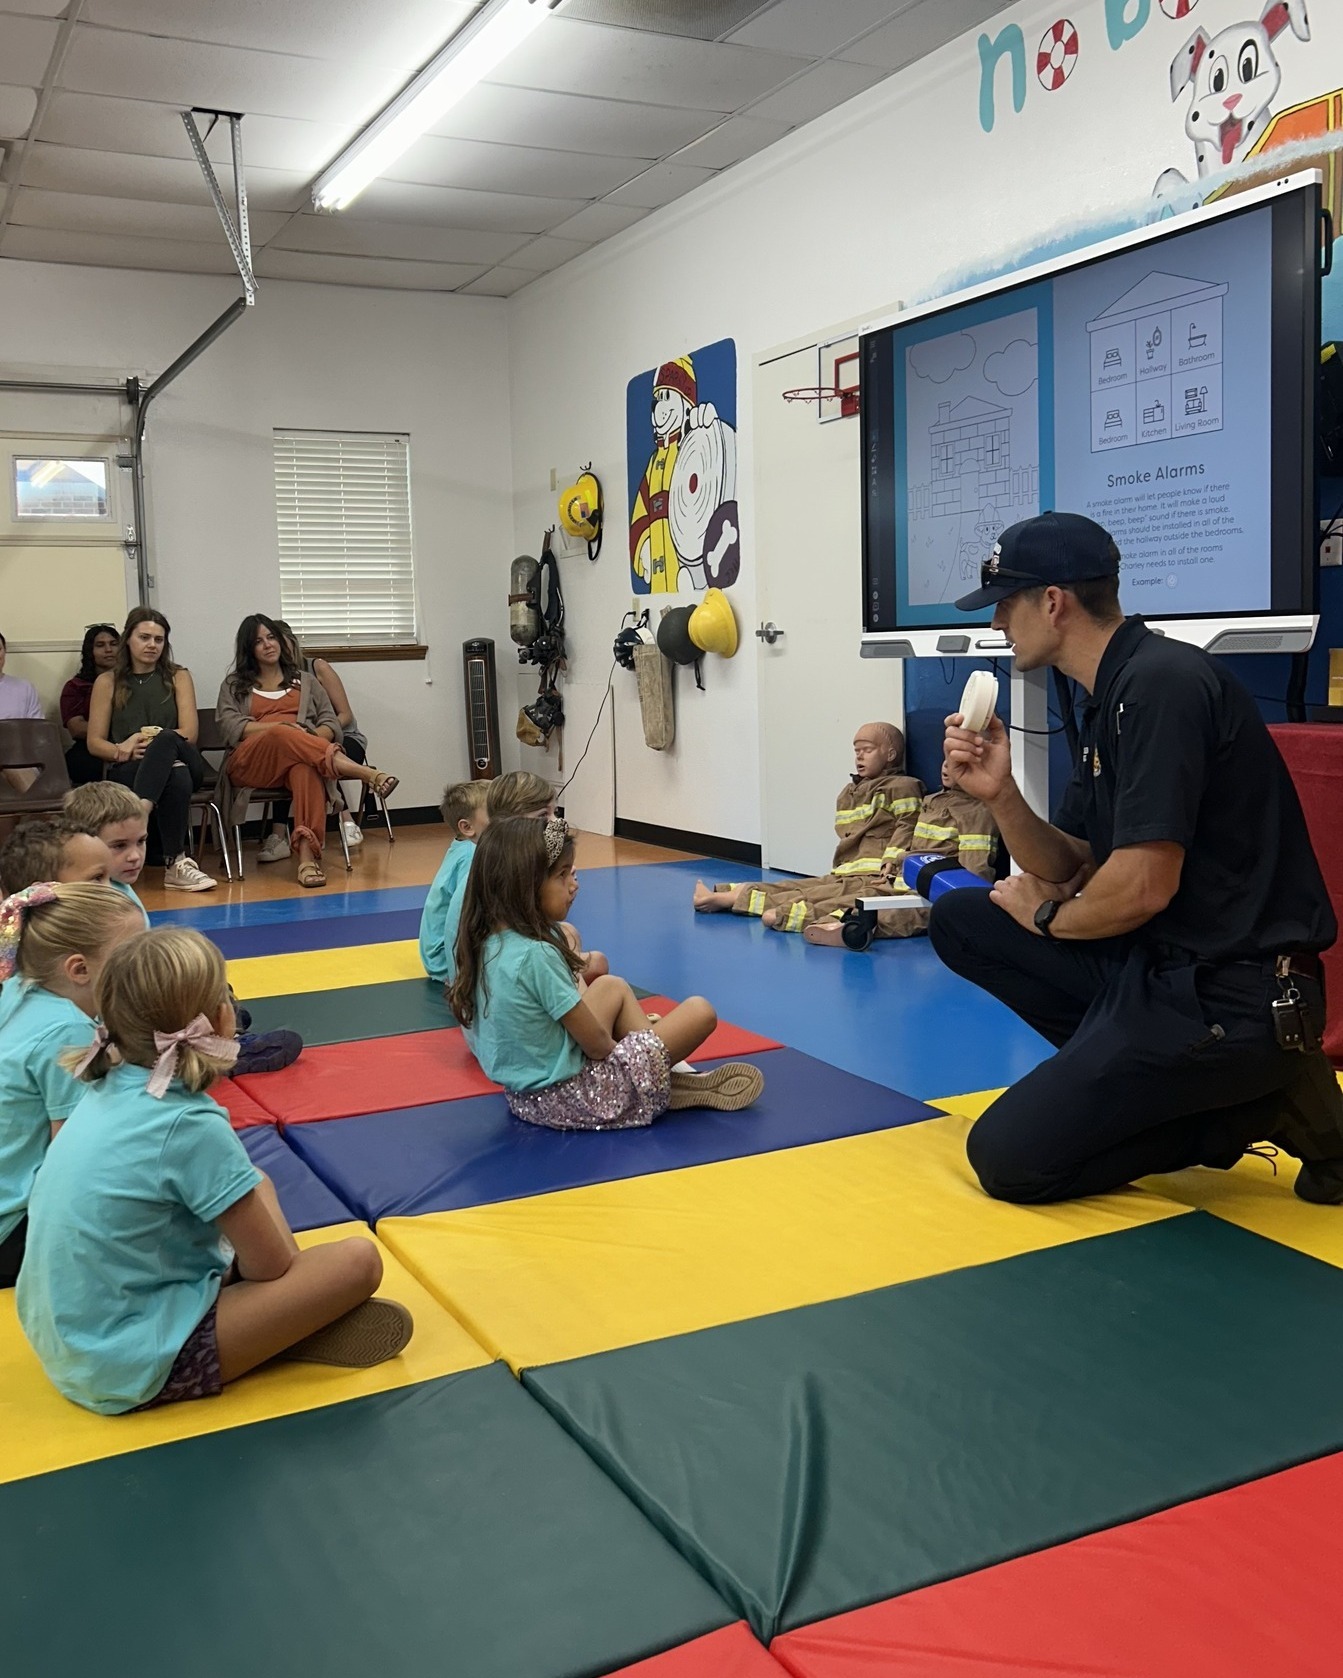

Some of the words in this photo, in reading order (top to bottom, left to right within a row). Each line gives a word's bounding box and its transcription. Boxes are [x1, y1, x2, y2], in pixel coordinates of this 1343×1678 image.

[1179, 352, 1215, 366] Bathroom
[1140, 364, 1167, 376] Hallway
[1098, 372, 1128, 385] Bedroom
[1174, 420, 1196, 432] Living
[1198, 416, 1220, 427] Room
[1142, 427, 1167, 438] Kitchen
[1098, 434, 1128, 446] Bedroom
[1107, 470, 1151, 488] Smoke
[1155, 464, 1205, 480] Alarms
[1092, 500, 1112, 508] smoke
[1114, 496, 1133, 504] alarm
[1134, 493, 1146, 502] will
[1146, 492, 1156, 500] let
[1157, 490, 1182, 500] people
[1183, 487, 1202, 496] know
[1204, 484, 1209, 492] if
[1210, 483, 1230, 492] there
[1122, 506, 1136, 514] their
[1167, 500, 1178, 508] will
[1180, 498, 1200, 506] make
[1208, 494, 1226, 503] loud
[1149, 512, 1170, 521] sound
[1171, 510, 1176, 518] if
[1178, 510, 1196, 518] there
[1204, 506, 1230, 514] smoke.
[1128, 525, 1150, 534] should
[1162, 520, 1192, 530] installed
[1202, 518, 1210, 526] all
[1212, 516, 1220, 526] of
[1222, 516, 1234, 524] the
[1136, 535, 1162, 544] hallway
[1164, 532, 1189, 541] outside
[1190, 530, 1204, 538] the
[1204, 527, 1244, 537] bedrooms.
[1138, 550, 1158, 558] alarm
[1168, 547, 1176, 556] all
[1178, 546, 1186, 554] of
[1186, 545, 1199, 554] the
[1200, 544, 1223, 553] rooms
[1120, 561, 1145, 570] Charley
[1146, 559, 1166, 568] needs
[1177, 556, 1198, 566] install
[1132, 578, 1164, 586] Example:
